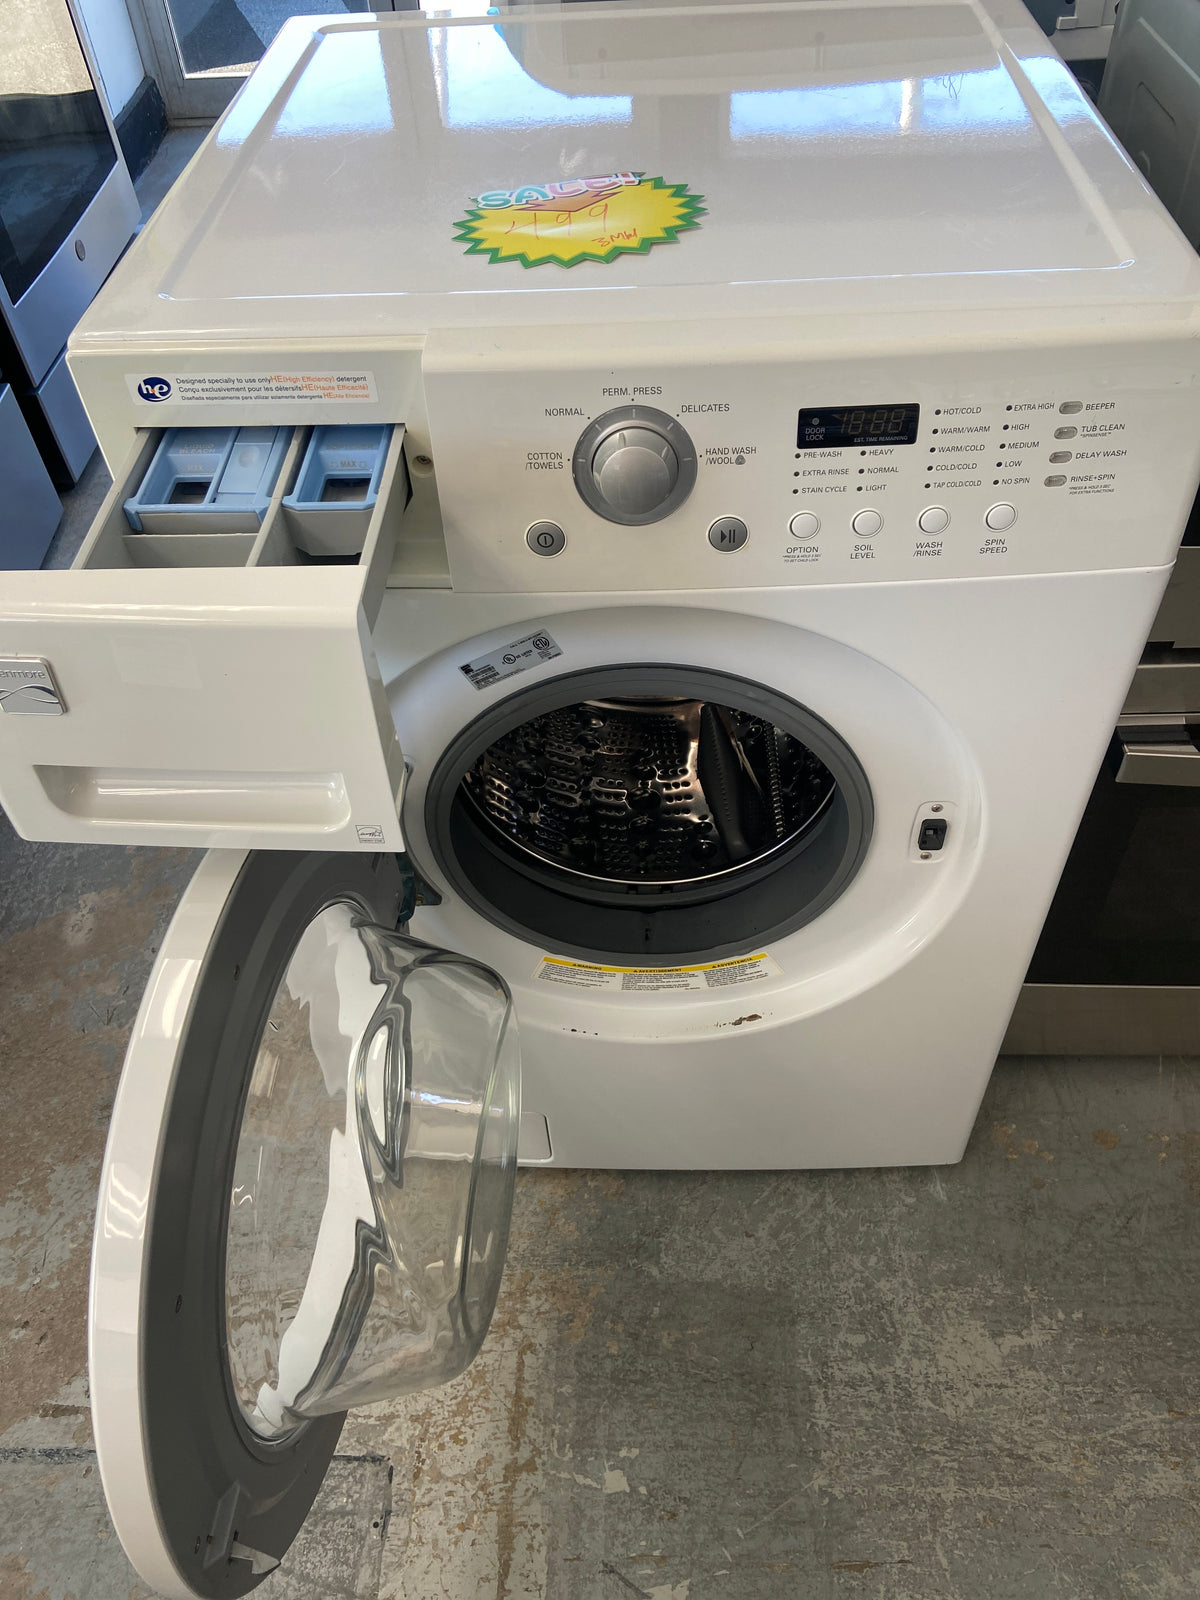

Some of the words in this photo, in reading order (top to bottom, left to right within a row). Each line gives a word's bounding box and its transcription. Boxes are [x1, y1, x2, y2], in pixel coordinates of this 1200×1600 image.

[175, 377, 206, 385] Designed
[207, 377, 235, 385] specially
[257, 377, 271, 385] only
[301, 375, 335, 383] Efficiency)
[336, 375, 367, 383] detergent
[178, 386, 200, 394] Conçu
[602, 388, 631, 397] PERM.
[633, 386, 663, 396] PRESS
[681, 403, 731, 413] DELICATES
[1013, 403, 1037, 412] EXTRA
[1037, 402, 1055, 410] HIGH
[1085, 402, 1116, 411] BEEPER
[545, 407, 585, 417] NORMAL
[943, 407, 982, 416] HOT/COLD
[805, 427, 826, 435] DOOR
[940, 426, 991, 435] WARM/WARM
[1011, 423, 1030, 431] HIGH
[1081, 425, 1098, 433] TUB
[1098, 424, 1126, 432] CLEAN
[938, 444, 986, 453] WARM/COLD
[1007, 441, 1040, 450] MEDIUM
[705, 447, 730, 456] HAND
[731, 446, 757, 455] WASH
[803, 451, 843, 459] PRE-WASH
[1075, 451, 1102, 460] DELAY
[1102, 449, 1128, 458] WASH
[527, 452, 563, 460] COTTON
[705, 457, 734, 466] /WOOL
[1004, 460, 1023, 468] LOW
[525, 461, 564, 472] /TOWELS
[935, 463, 978, 471] COLD/COLD
[802, 469, 827, 477] EXTRA
[1013, 477, 1031, 485] SPIN
[1070, 474, 1116, 482] RINSE+SPIN
[865, 484, 887, 492] LIGHT
[946, 480, 982, 488] COLD/COLD
[824, 485, 848, 493] CYCLE
[915, 541, 943, 549] WASH
[984, 538, 1006, 546] SPIN
[786, 546, 819, 554] OPTION
[854, 544, 874, 552] SOIL
[979, 546, 1008, 555] SPEED
[850, 552, 876, 560] LEVEL
[913, 549, 942, 557] /RINSE
